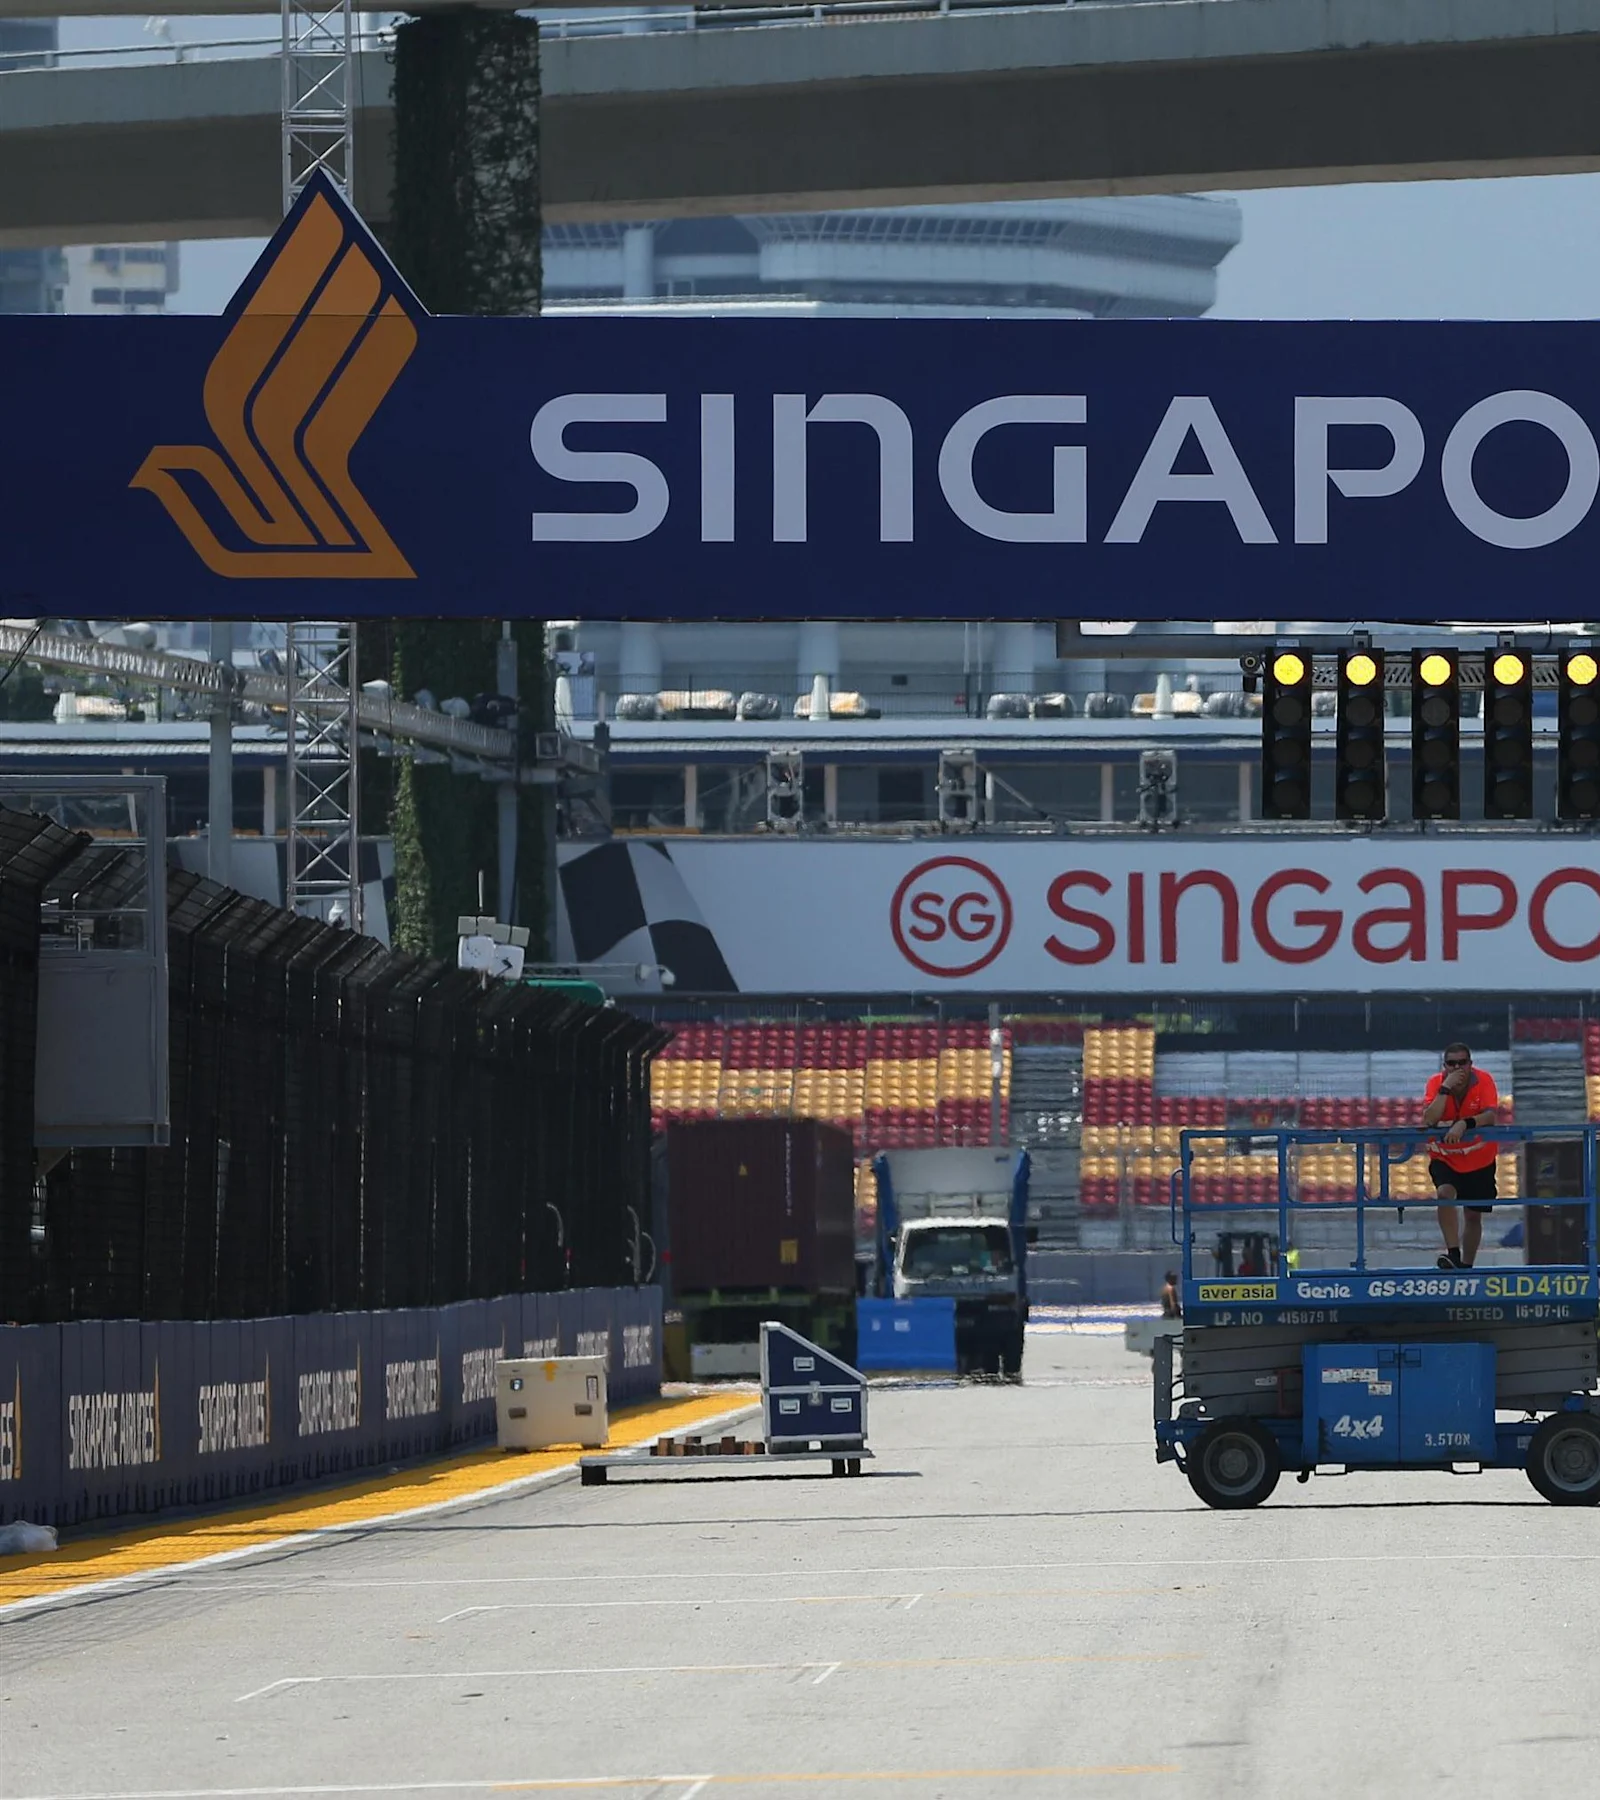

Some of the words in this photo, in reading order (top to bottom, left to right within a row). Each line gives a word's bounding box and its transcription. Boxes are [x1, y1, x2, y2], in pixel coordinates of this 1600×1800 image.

[909, 892, 996, 941] SG
[1201, 1287, 1237, 1299] aver
[1241, 1284, 1274, 1299] asia
[1297, 1282, 1351, 1299] Genie
[1367, 1279, 1450, 1297] GS-3369
[1453, 1278, 1480, 1296] RT
[1241, 1311, 1264, 1326] NO
[1446, 1307, 1504, 1321] TESTED
[1515, 1304, 1569, 1318] 16-07-16
[1333, 1414, 1384, 1440] 4x4
